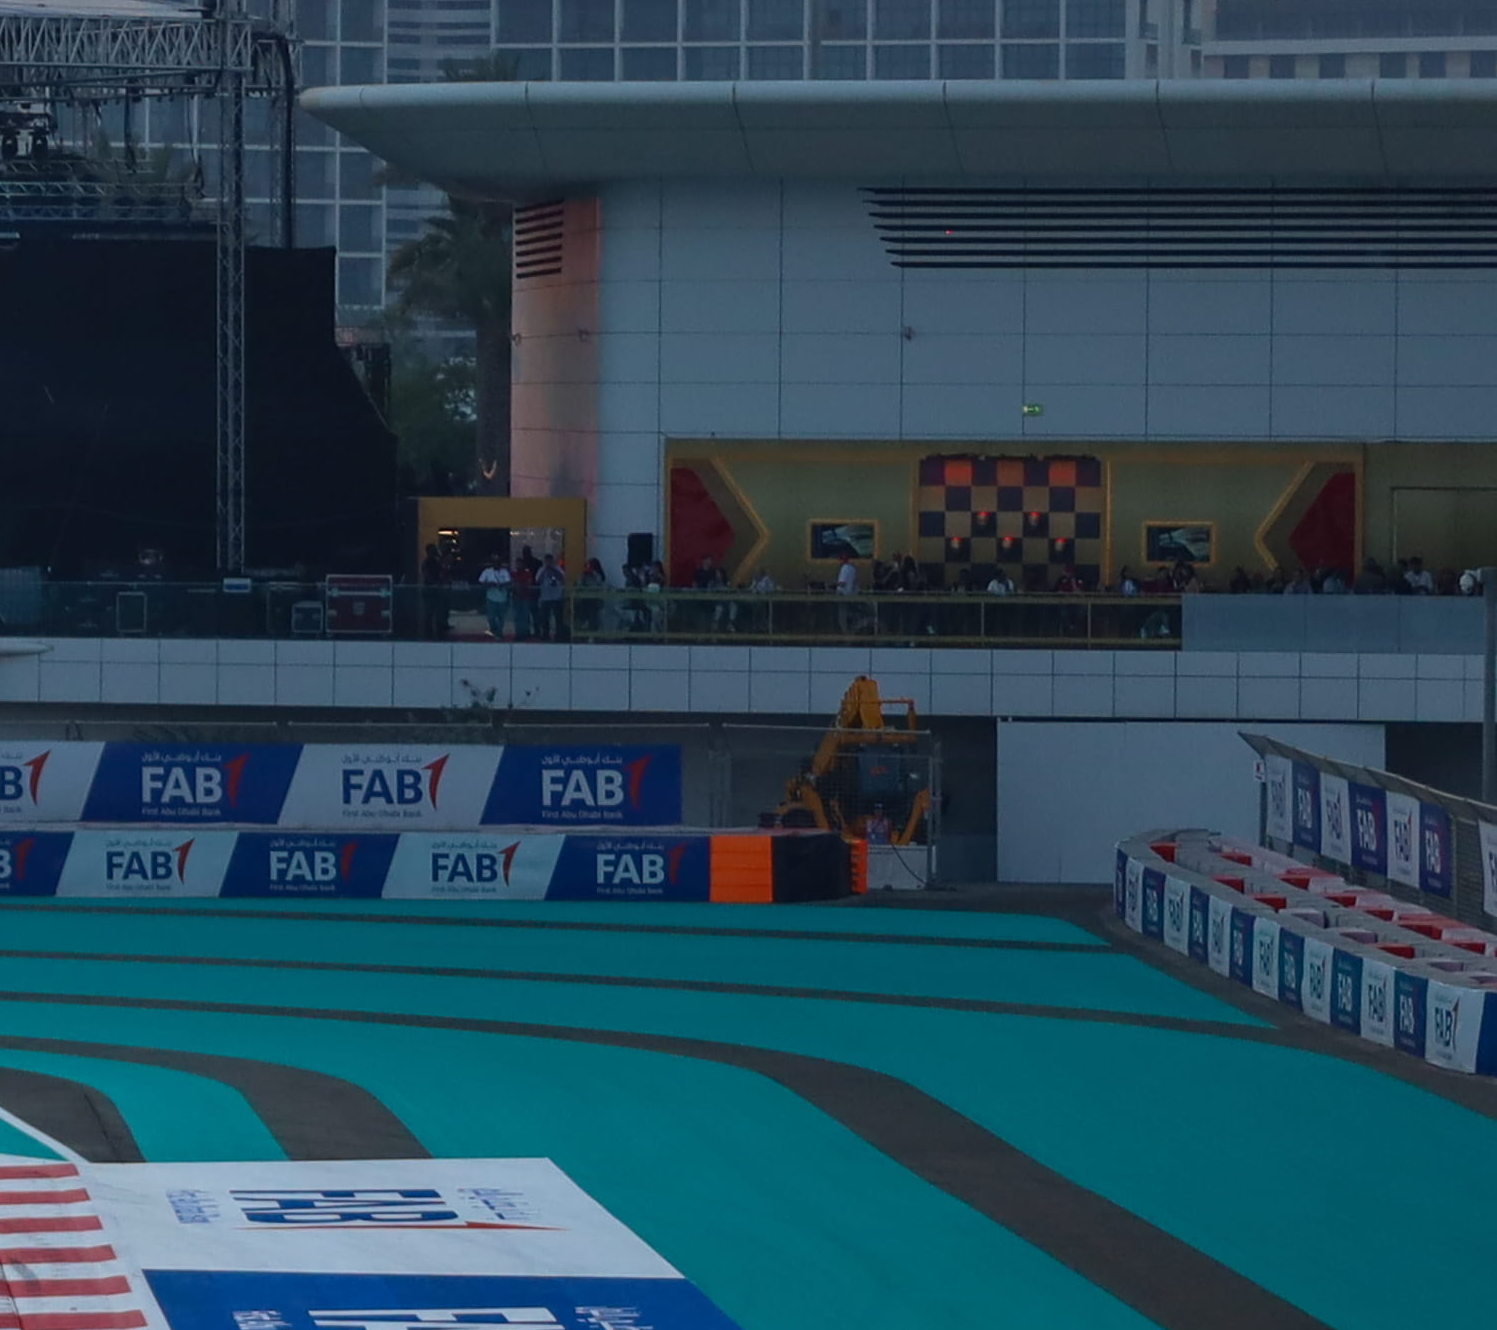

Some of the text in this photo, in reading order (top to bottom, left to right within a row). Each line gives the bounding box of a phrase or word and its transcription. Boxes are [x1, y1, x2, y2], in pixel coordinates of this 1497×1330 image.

[141, 766, 224, 805] FAB
[342, 769, 424, 806] FAB
[541, 769, 625, 807] FAB
[106, 851, 173, 880] FAB
[269, 851, 338, 881] FAB
[431, 853, 498, 883] FAB
[596, 853, 665, 885] FAB
